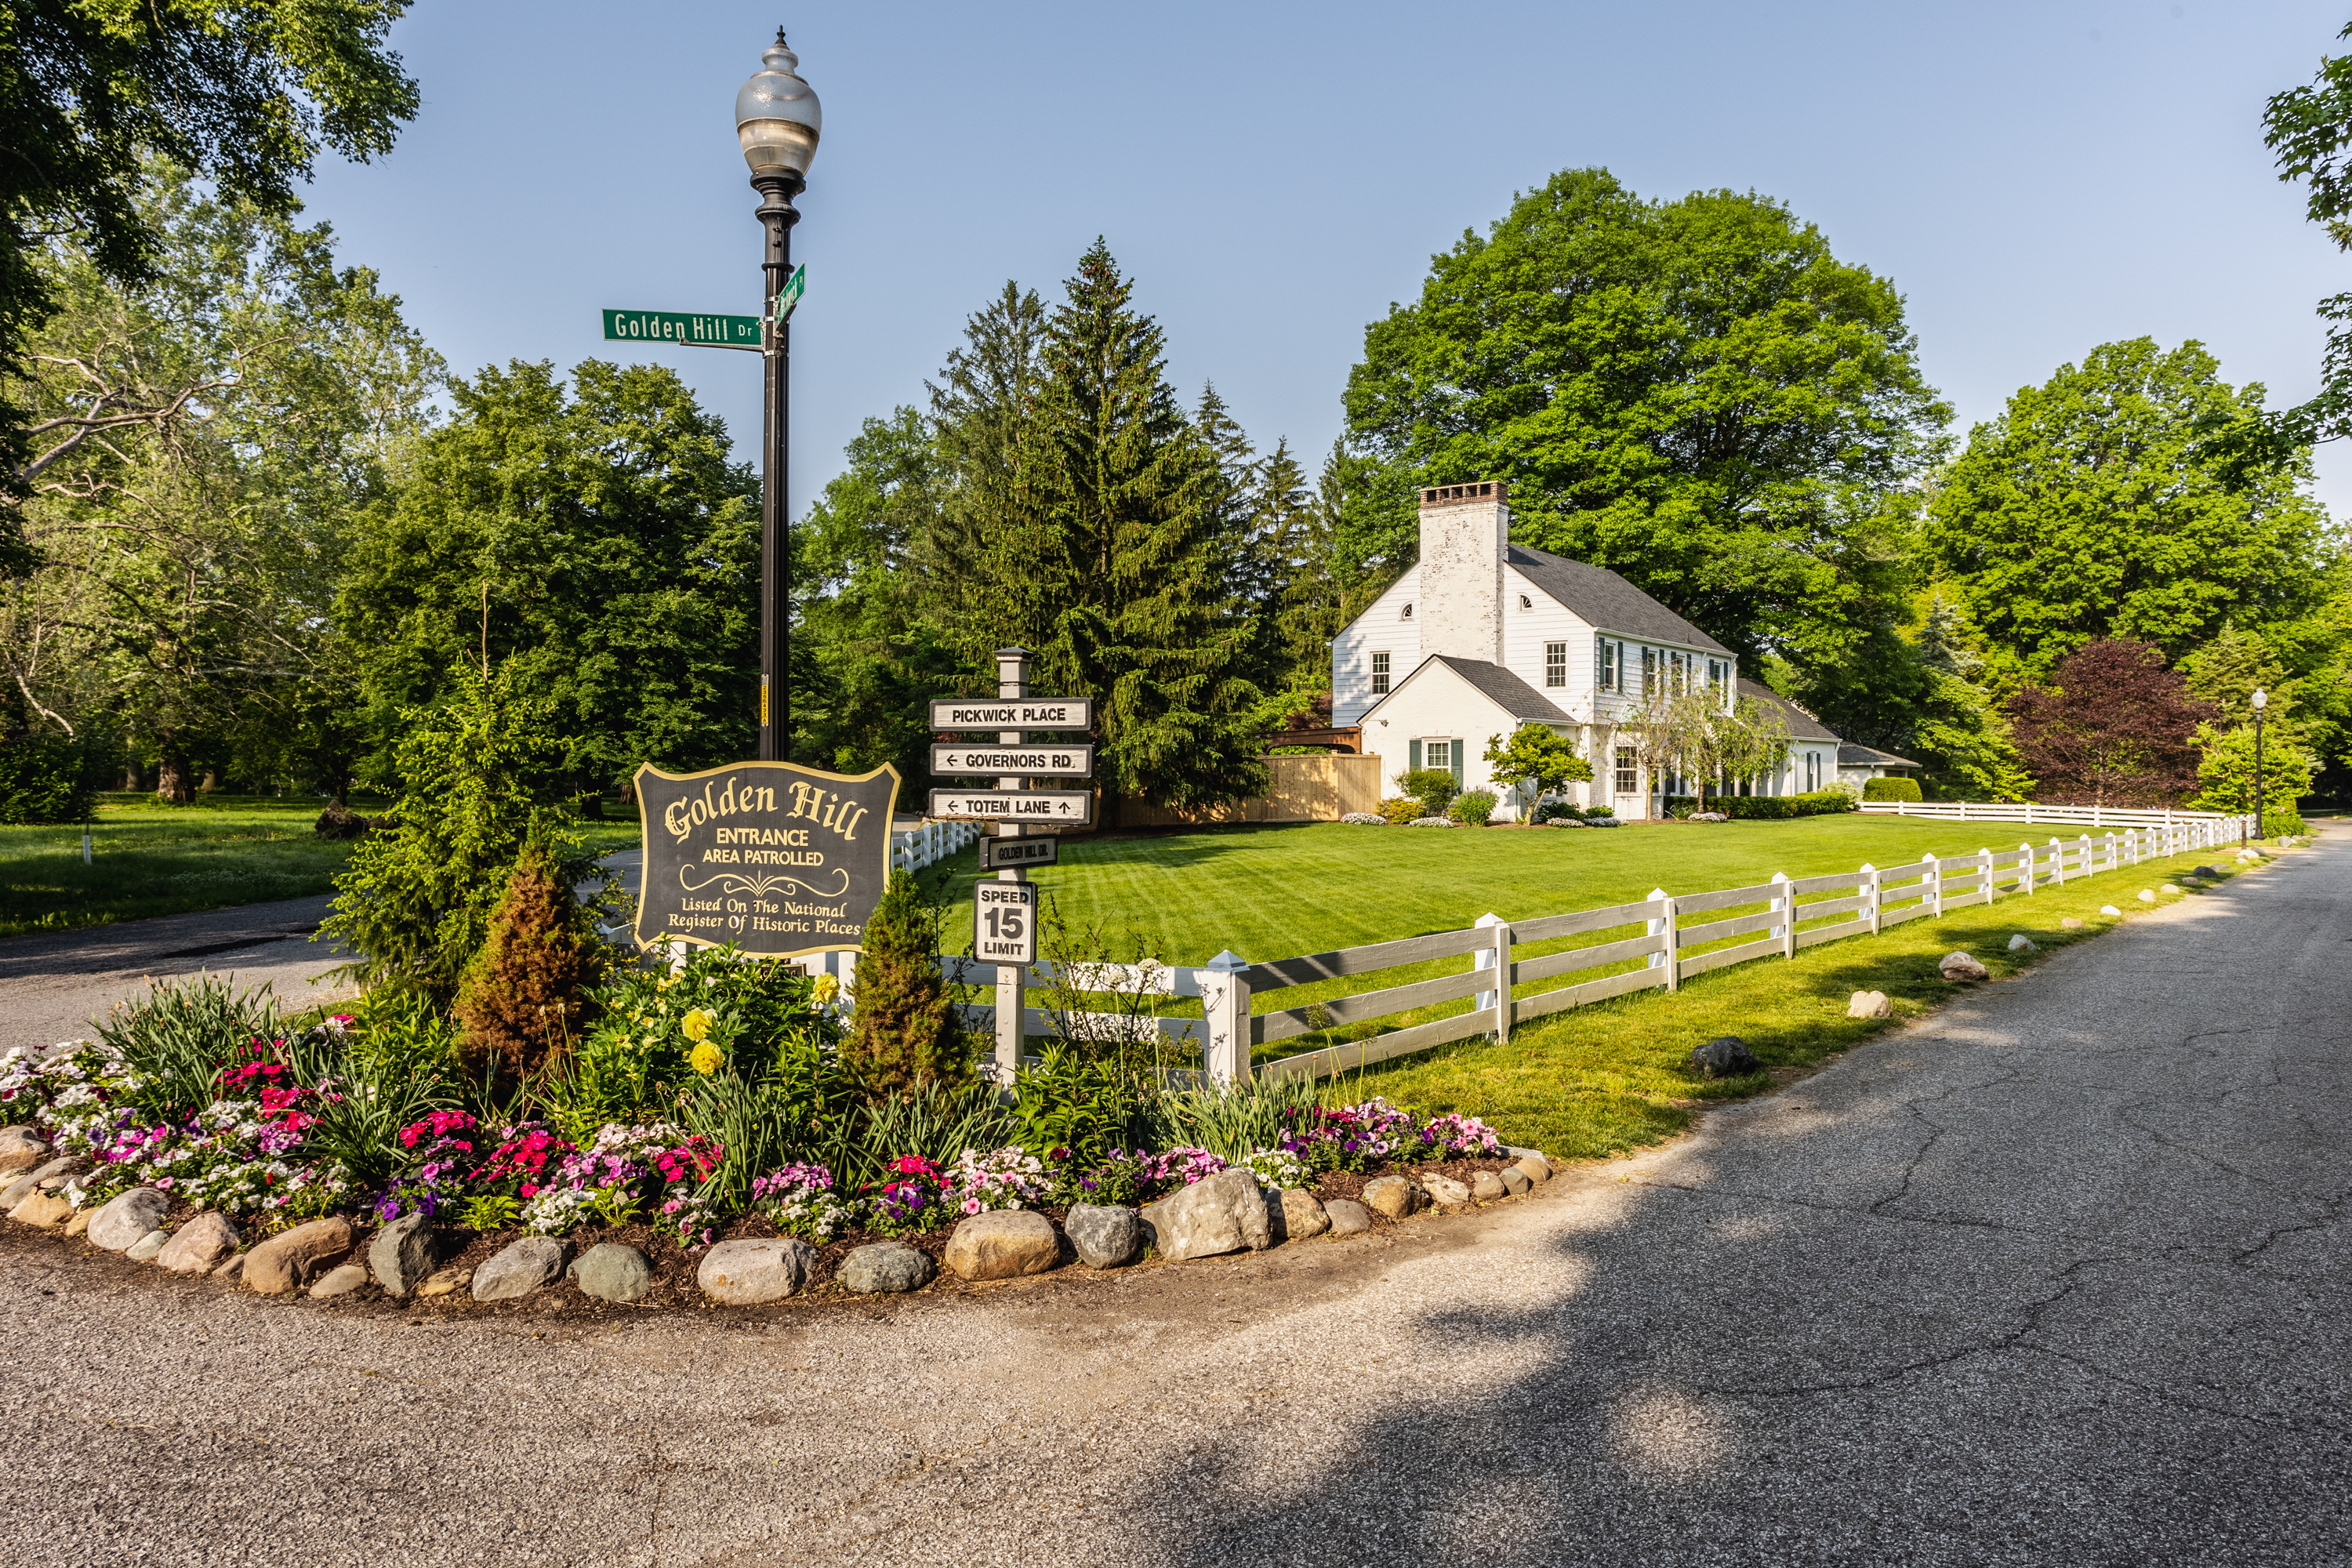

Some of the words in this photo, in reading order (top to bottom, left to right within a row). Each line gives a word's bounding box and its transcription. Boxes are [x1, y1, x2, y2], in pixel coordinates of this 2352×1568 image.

[615, 313, 685, 338] Golden
[693, 317, 728, 340] Hill
[738, 324, 753, 336] Dr
[952, 709, 1017, 723] PICKWICK
[1022, 707, 1066, 721] PLACE
[966, 754, 1046, 768] GOVERNORS
[1051, 754, 1076, 768] RD.
[665, 776, 779, 844] Golden
[786, 781, 869, 840] Hill
[965, 800, 1011, 813] TOTEM
[1015, 800, 1051, 814] LANE
[716, 827, 809, 847] ENTRANCE
[702, 849, 741, 864] AREA
[744, 849, 824, 866] PATROLLED
[999, 846, 1023, 861] GOLDEN
[1025, 844, 1037, 858] HILL
[981, 890, 1029, 904] SPEED
[681, 897, 723, 912] Listed
[727, 898, 747, 913] On
[753, 899, 779, 914] The
[784, 901, 848, 918] National
[668, 913, 724, 932] Register
[728, 914, 748, 935] Of
[753, 916, 811, 933] Historic
[815, 919, 861, 936] Places
[984, 907, 1023, 939] 15
[984, 942, 1024, 956] LIMIT
